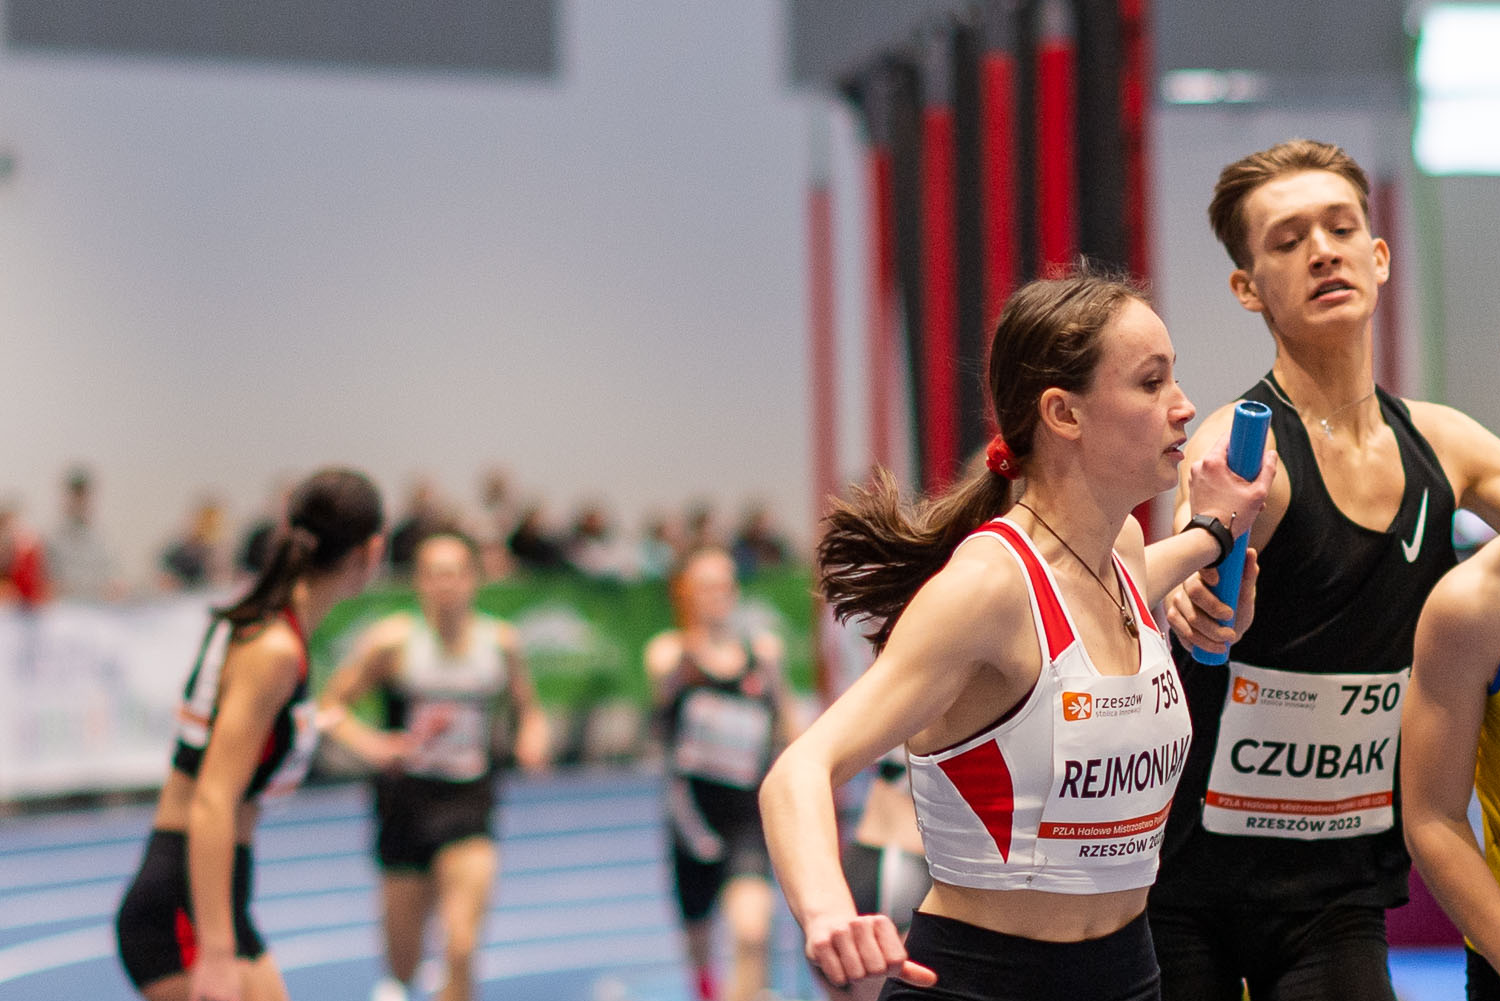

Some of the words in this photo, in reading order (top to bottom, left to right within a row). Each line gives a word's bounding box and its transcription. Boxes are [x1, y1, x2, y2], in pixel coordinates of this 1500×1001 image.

[1095, 693, 1143, 709] rzeszów
[1151, 669, 1179, 715] 758
[1261, 688, 1318, 702] rzeszów
[1340, 682, 1401, 716] 750
[1058, 734, 1190, 799] REJMONIAK
[1230, 736, 1391, 779] CZUBAK
[1052, 825, 1075, 836] PZLA
[1077, 825, 1112, 836] Halowe
[1246, 816, 1326, 832] RZESZÓW
[1328, 815, 1361, 832] 2023
[1079, 838, 1148, 858] RZESZÓW
